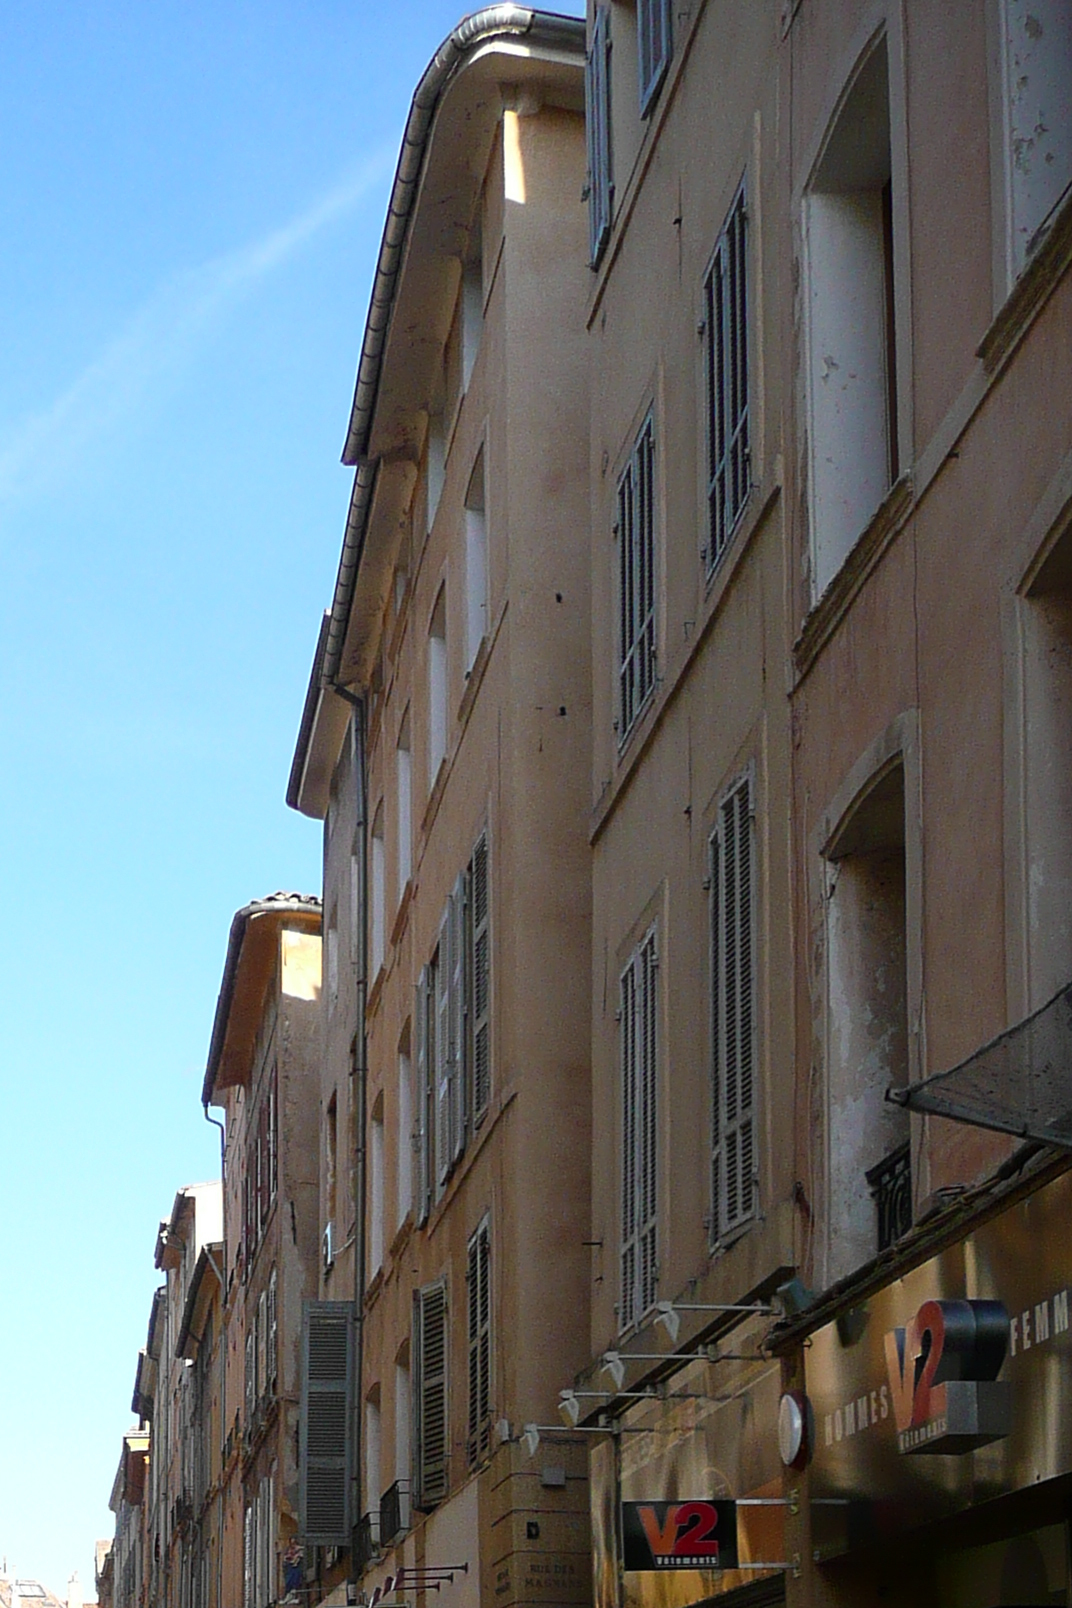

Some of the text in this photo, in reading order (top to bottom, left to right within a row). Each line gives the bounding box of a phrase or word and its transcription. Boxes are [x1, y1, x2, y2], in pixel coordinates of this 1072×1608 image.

[824, 1385, 889, 1446] HOMMES
[636, 1501, 719, 1555] V2
[530, 1564, 575, 1574] RUE DES
[656, 1556, 717, 1565] Vêtements
